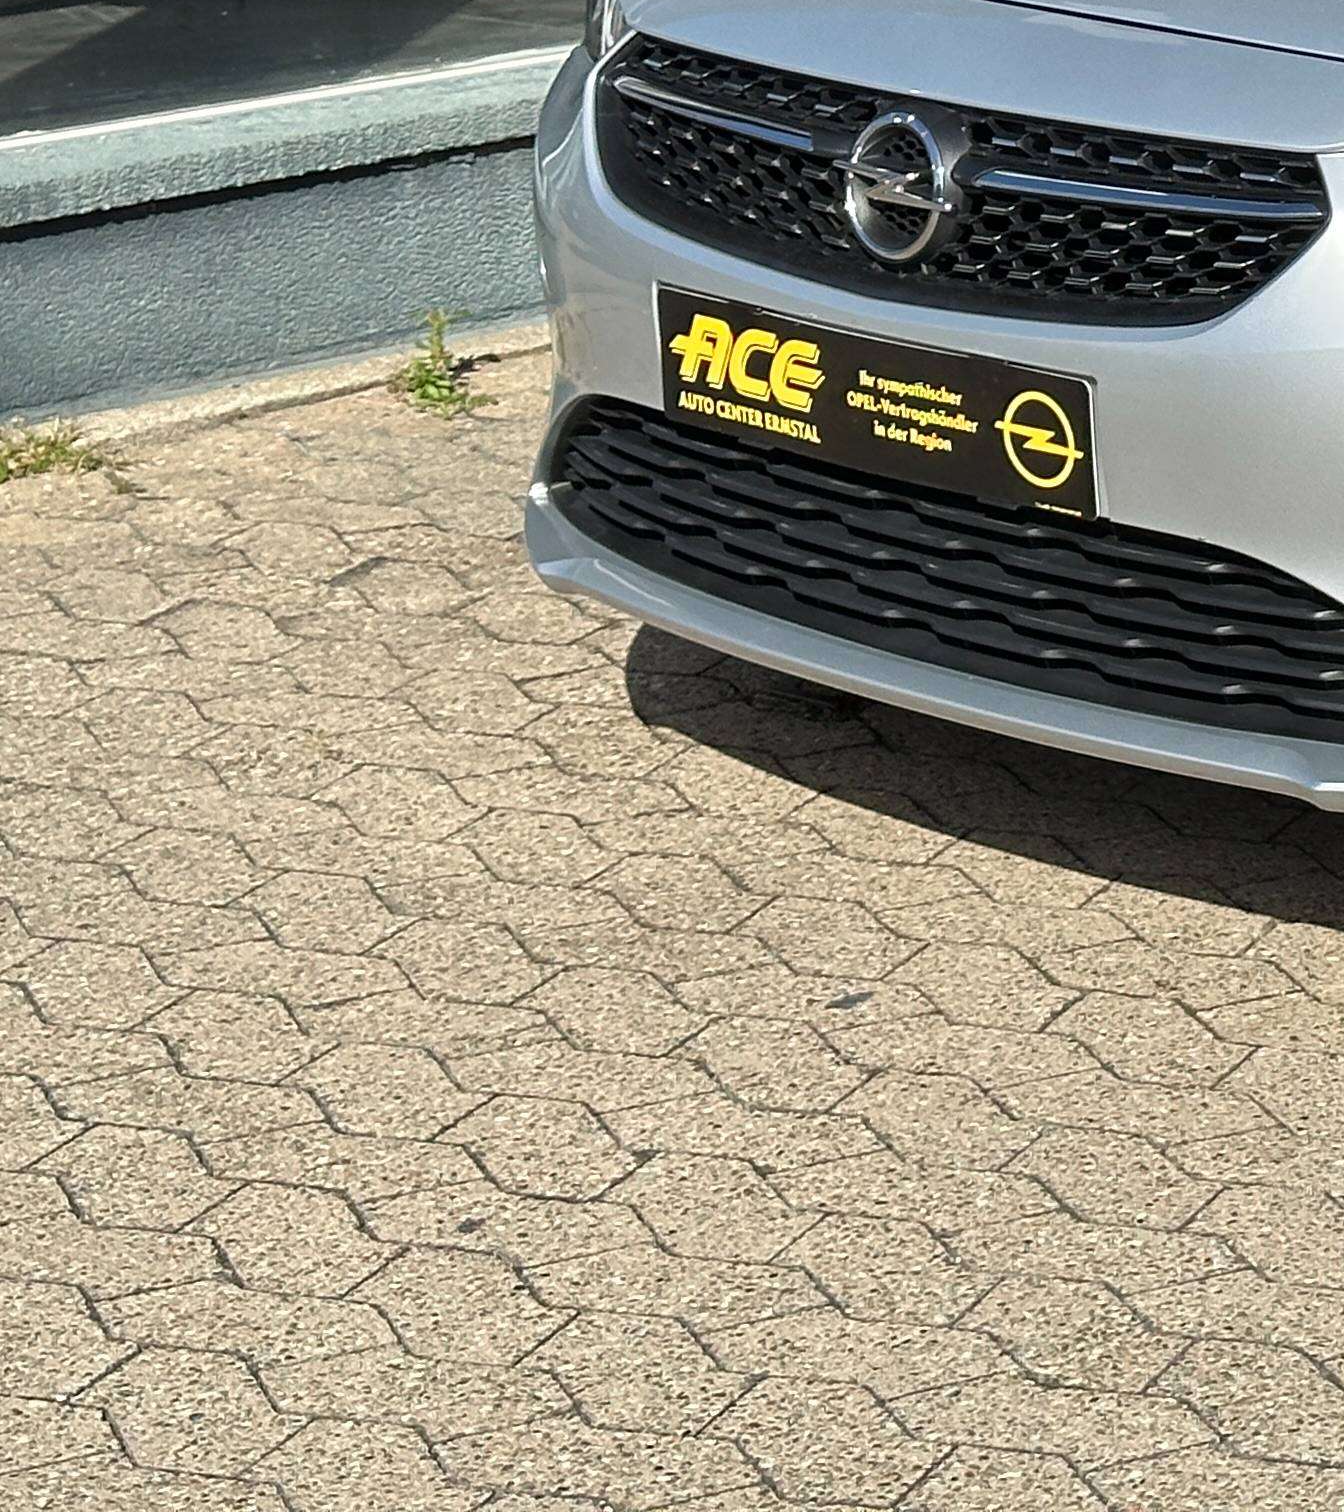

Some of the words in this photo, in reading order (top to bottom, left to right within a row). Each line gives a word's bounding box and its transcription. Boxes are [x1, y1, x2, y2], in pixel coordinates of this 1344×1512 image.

[669, 313, 826, 414] ACE
[858, 369, 876, 388] Ihr
[876, 376, 963, 406] sympathischer
[678, 390, 715, 416] AUTO
[715, 399, 764, 429] CENTER
[764, 412, 822, 444] ERMSTAL
[846, 390, 979, 433] OPEL-Vertragshändler
[873, 419, 886, 437] in
[886, 422, 909, 442] der
[909, 427, 953, 452] Region
